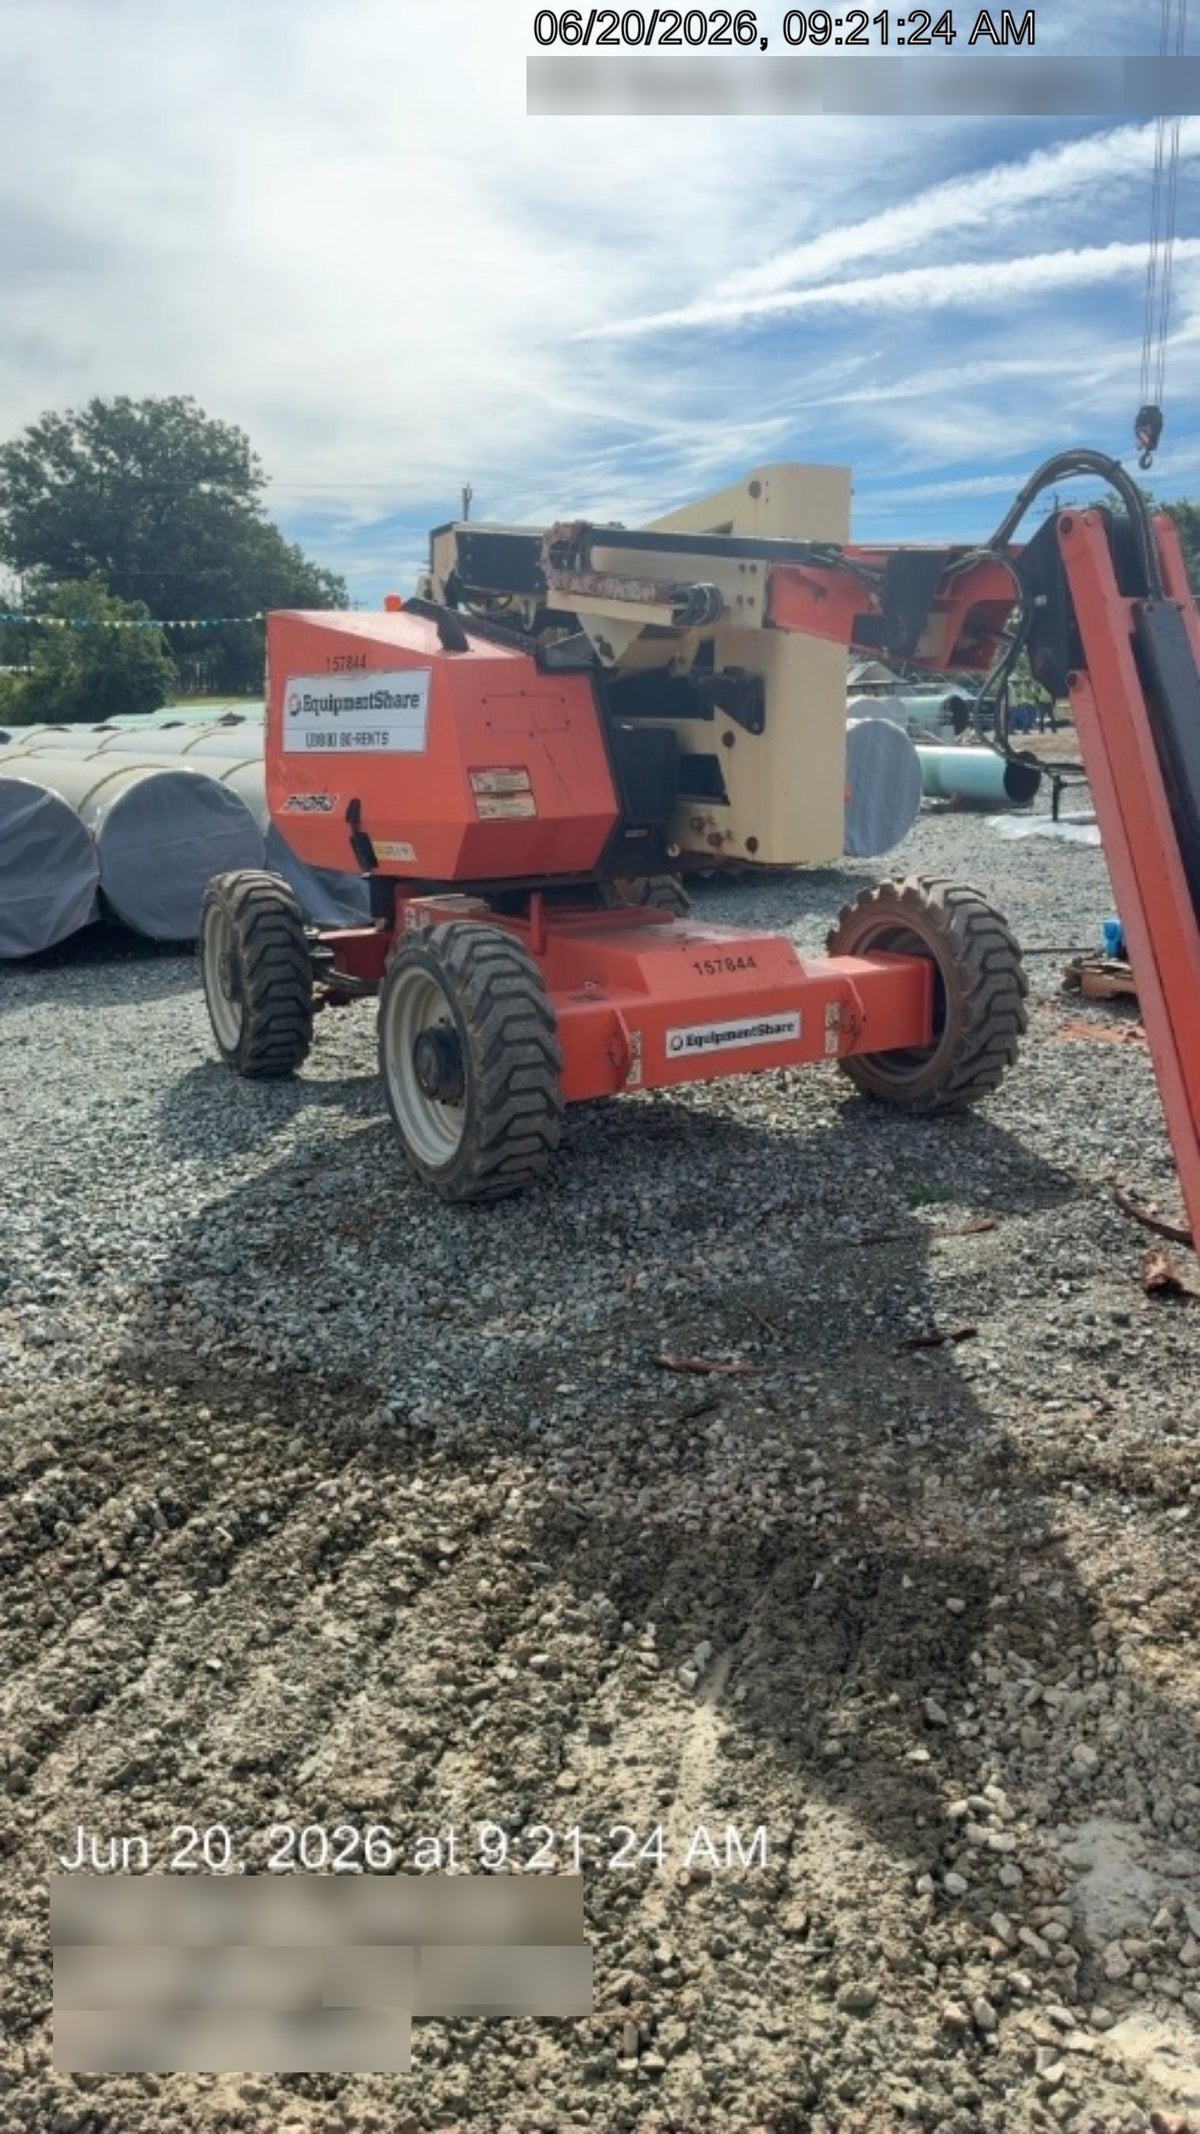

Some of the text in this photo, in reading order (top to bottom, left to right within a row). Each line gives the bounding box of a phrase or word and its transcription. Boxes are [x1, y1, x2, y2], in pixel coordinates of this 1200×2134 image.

[326, 653, 366, 672] 157844
[303, 690, 420, 716] EquipmentShare
[692, 956, 757, 976] 157844
[685, 1022, 795, 1048] EquipmentShare
